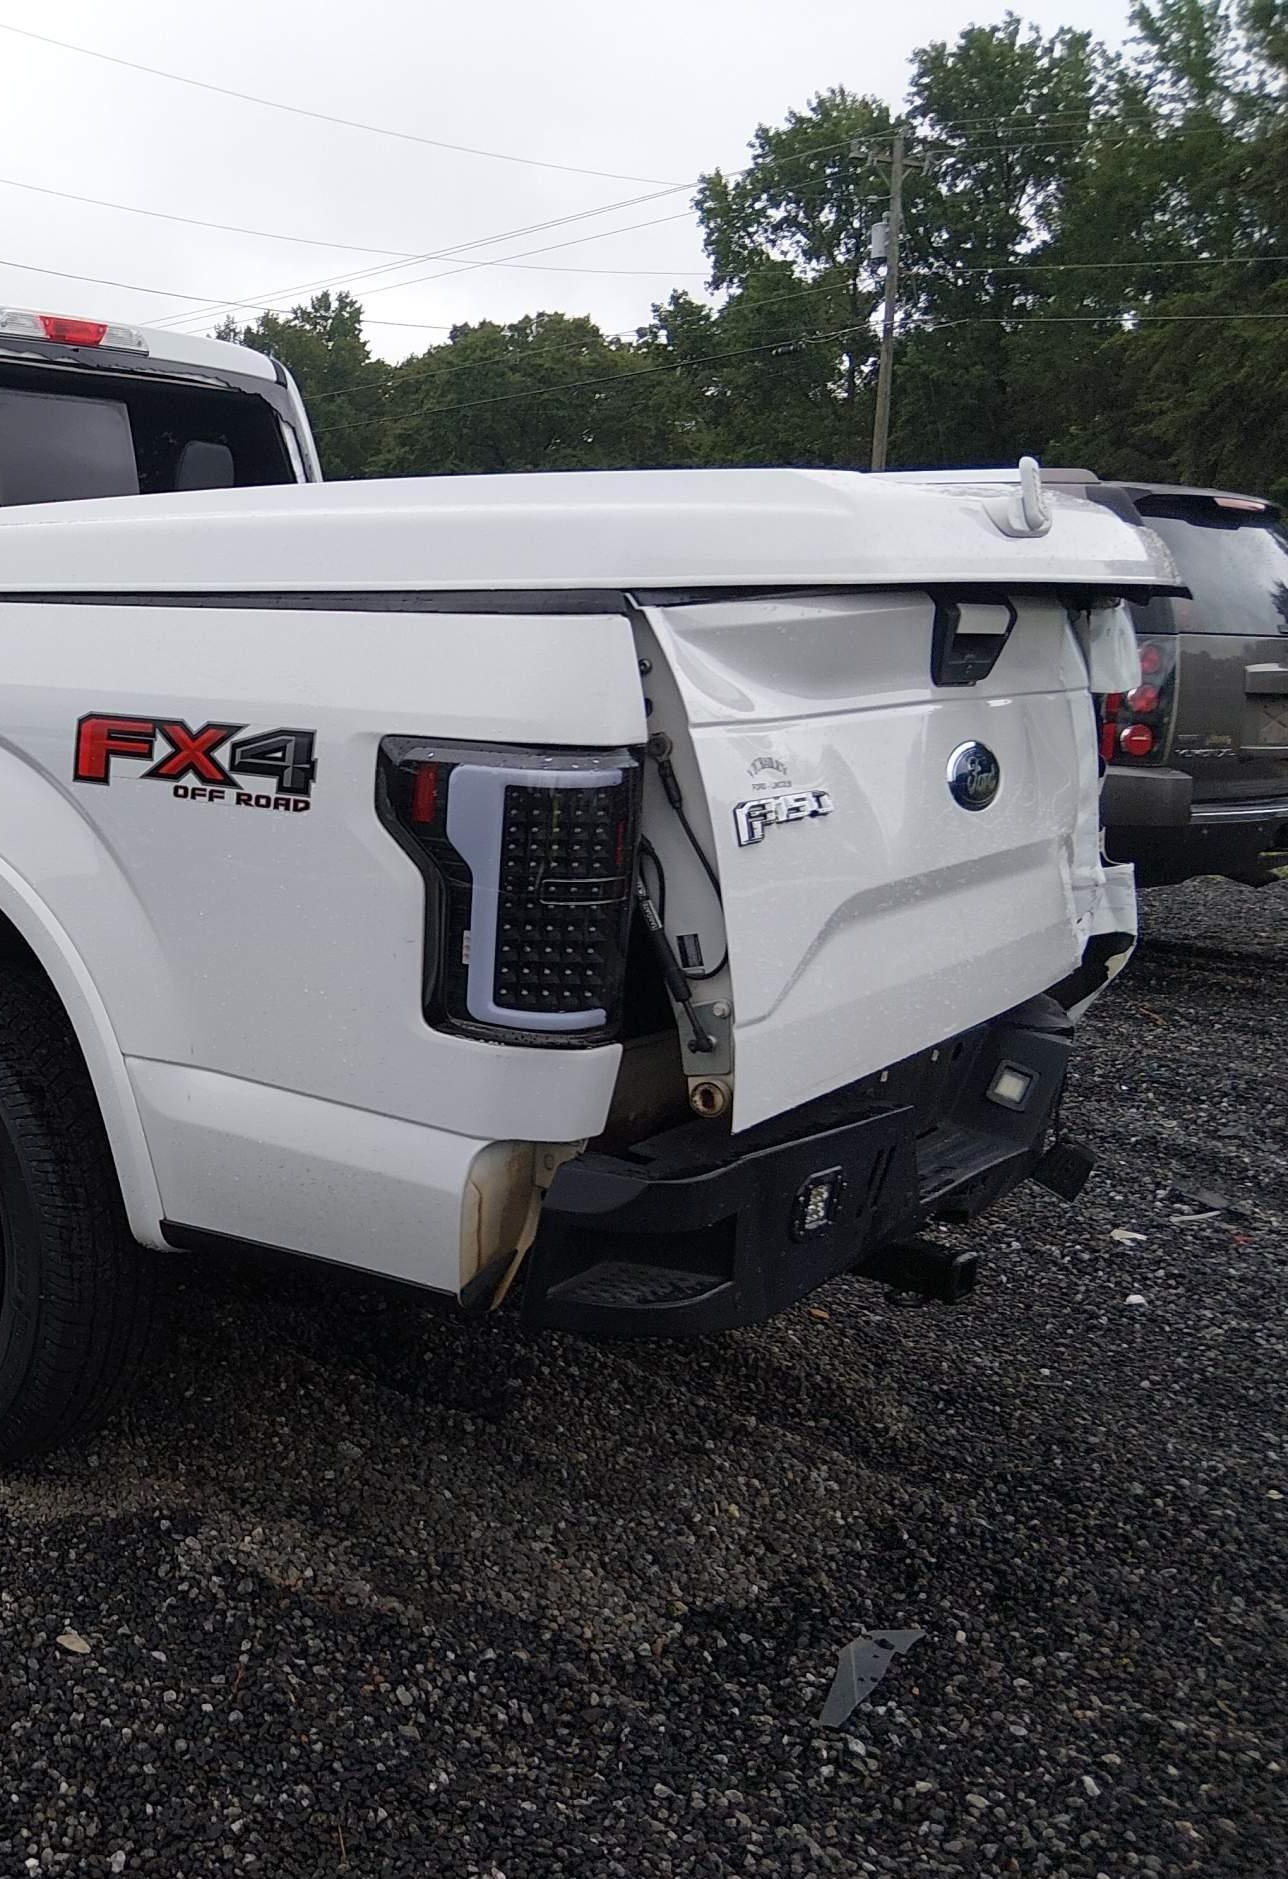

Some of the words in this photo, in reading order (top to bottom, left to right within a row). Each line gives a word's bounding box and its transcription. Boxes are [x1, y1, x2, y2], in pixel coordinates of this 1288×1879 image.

[73, 711, 318, 798] FX4
[172, 784, 226, 802] OFF
[235, 791, 311, 812] ROAD
